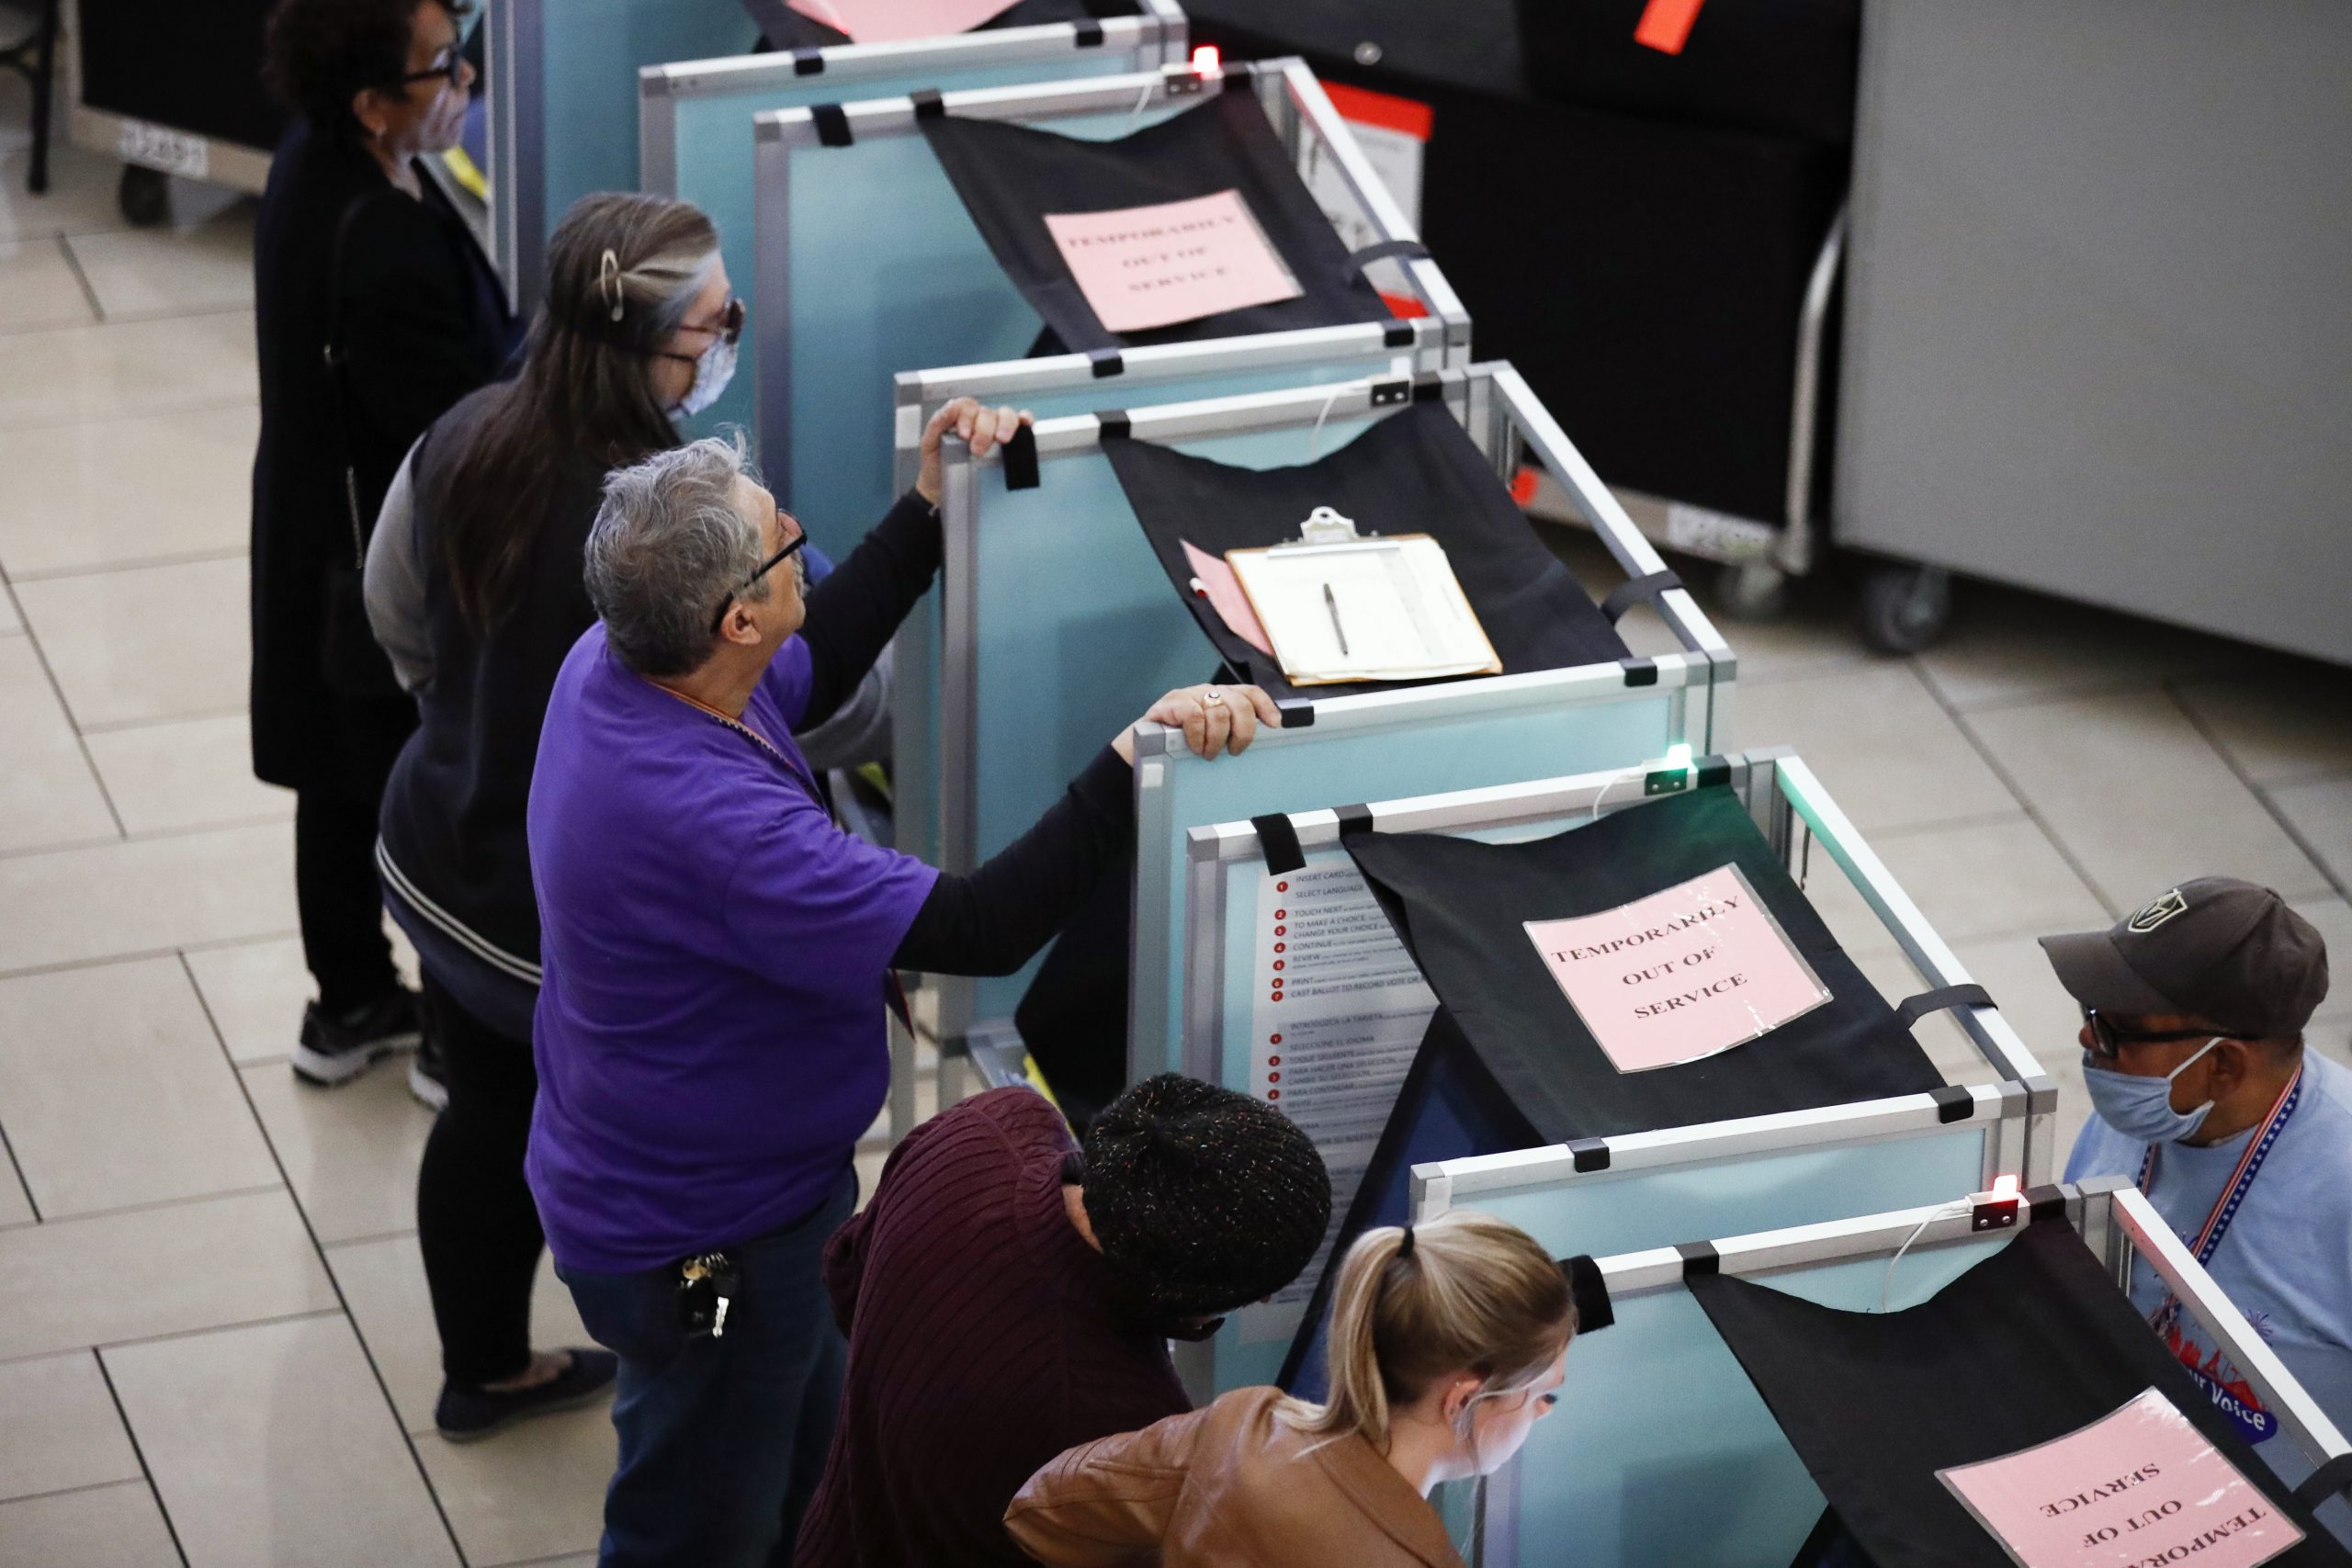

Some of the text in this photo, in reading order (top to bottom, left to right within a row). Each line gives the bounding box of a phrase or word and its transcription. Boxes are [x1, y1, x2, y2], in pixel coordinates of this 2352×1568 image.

[1122, 246, 1206, 267] OUT OF
[1128, 267, 1227, 291] SERVICE
[1295, 873, 1321, 882] INSERT
[1323, 870, 1344, 880] CARD
[1295, 884, 1363, 898] SELECT LANGUAGE
[1295, 908, 1321, 917] TOUCH
[1323, 905, 1342, 914] NEXT
[1306, 919, 1327, 928] MAKE
[1551, 896, 1738, 963] TEMPORARILY
[1294, 928, 1324, 939] CHANGE
[1328, 925, 1350, 934] YOUR
[1293, 940, 1332, 951] CONTINUE
[1293, 953, 1320, 962] REVIEW
[1623, 945, 1716, 985] OUT OF
[1292, 976, 1314, 986] PRINT
[1291, 988, 1309, 998] CAST
[1312, 986, 1340, 995] BALLOT
[1634, 973, 1747, 1019] SERVICE
[2211, 1382, 2266, 1431] Voice
[2040, 1462, 2161, 1517] SERVICE
[2084, 1500, 2182, 1548] OUT OF
